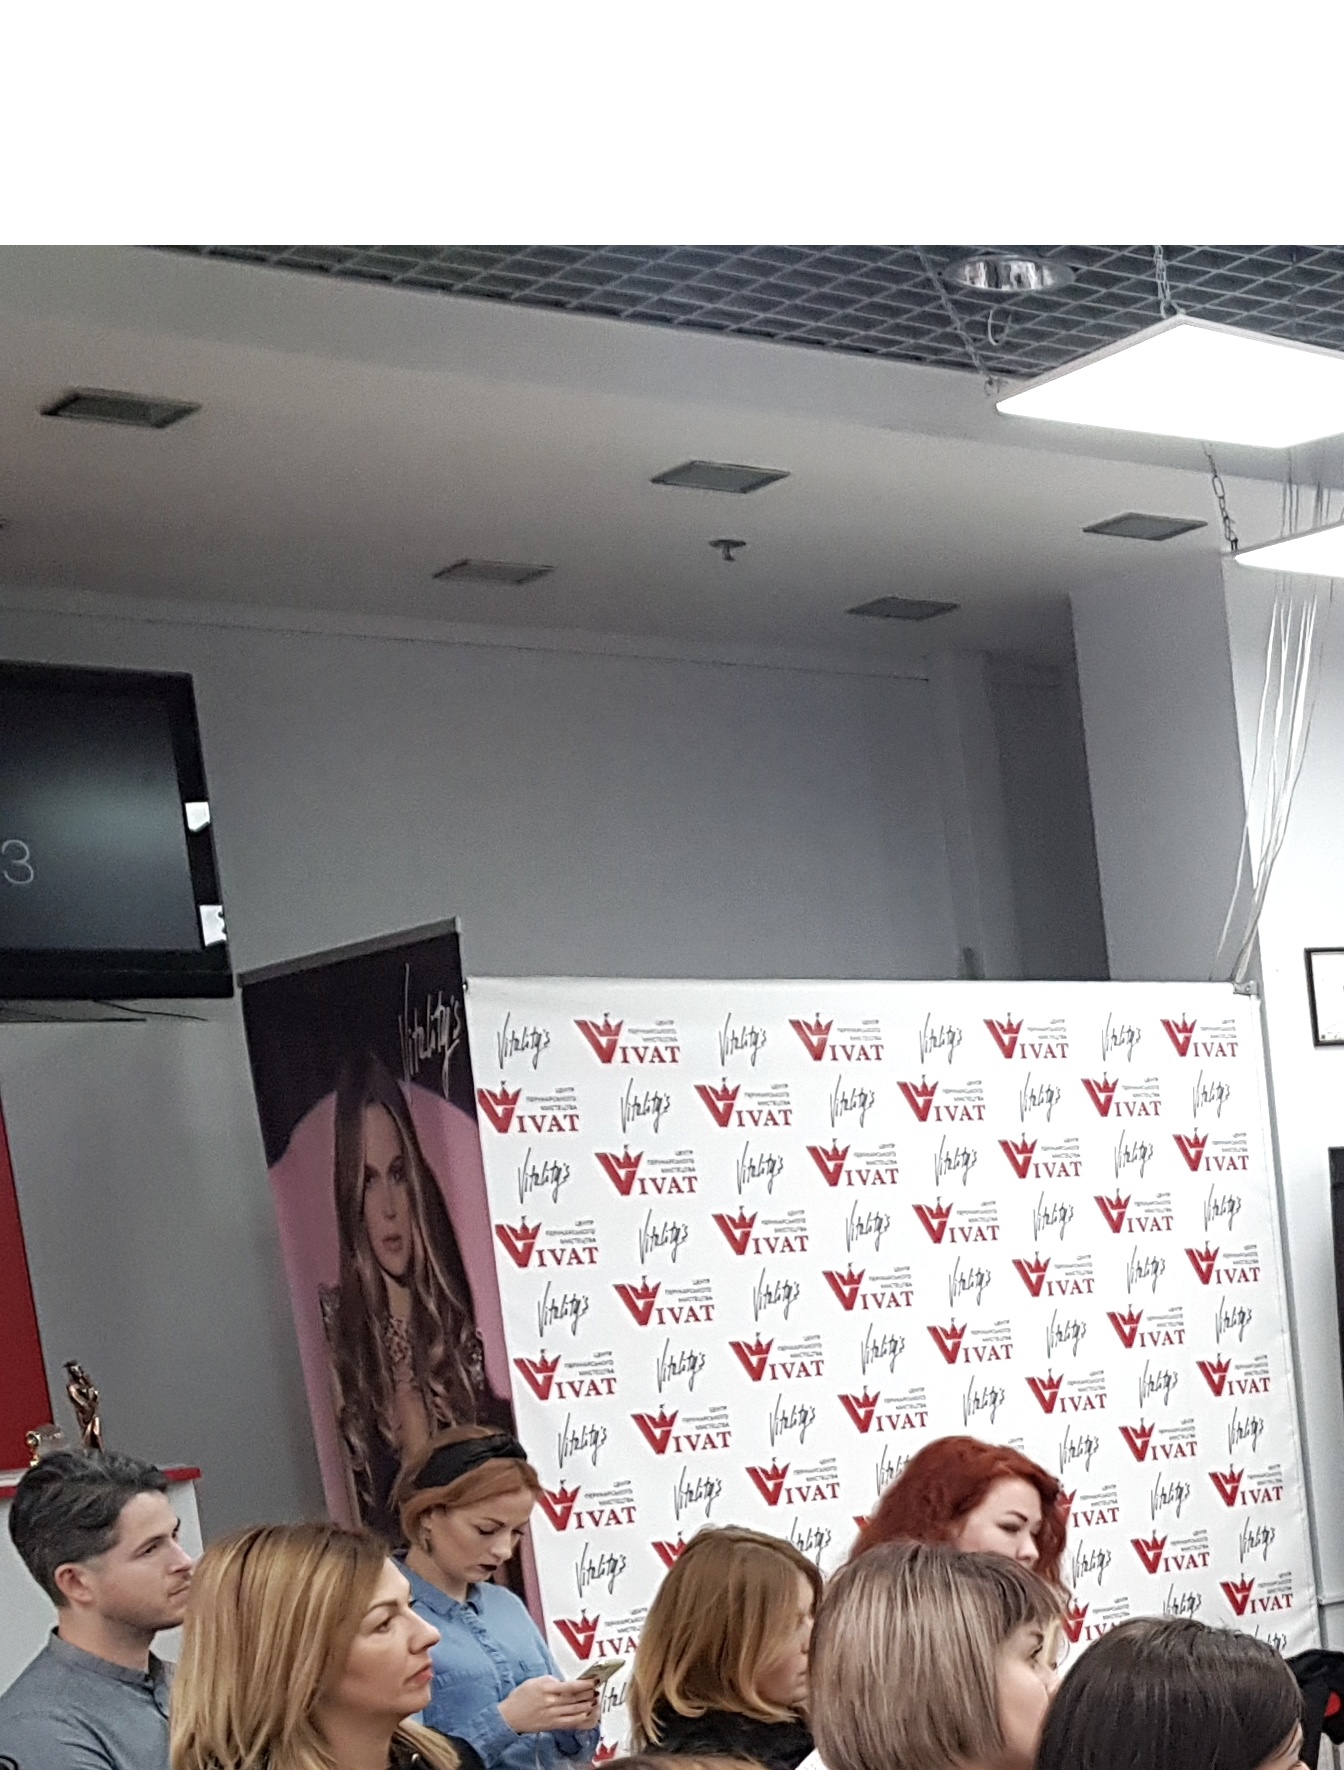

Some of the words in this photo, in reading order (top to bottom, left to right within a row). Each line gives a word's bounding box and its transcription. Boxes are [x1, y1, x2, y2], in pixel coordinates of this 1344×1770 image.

[573, 1019, 680, 1064] VIVAT
[788, 1019, 884, 1061] VIVAT
[983, 1018, 1069, 1059] VIVAT
[1160, 1018, 1238, 1057] VIVAT
[476, 1087, 580, 1133] VIVAT
[694, 1084, 793, 1128] VIVAT
[897, 1080, 985, 1122] VIVAT
[1081, 1077, 1161, 1117] VIVAT
[806, 1144, 899, 1187] VIVAT
[998, 1138, 1082, 1179] VIVAT
[1172, 1132, 1249, 1172] VIVAT
[594, 1151, 698, 1196] VIVAT
[712, 1211, 809, 1256] VIVAT
[912, 1202, 1000, 1244] VIVAT
[1093, 1194, 1174, 1234] VIVAT
[495, 1222, 599, 1268] VIVAT
[1184, 1246, 1260, 1285] VIVAT
[821, 1268, 914, 1311] VIVAT
[1012, 1256, 1094, 1297] VIVAT
[612, 1281, 715, 1326] VIVAT
[927, 1322, 1013, 1364] VIVAT
[1106, 1309, 1185, 1348] VIVAT
[513, 1354, 617, 1401] VIVAT
[728, 1338, 825, 1382] VIVAT
[1196, 1358, 1270, 1397] VIVAT
[837, 1390, 929, 1434] VIVAT
[1025, 1373, 1107, 1414] VIVAT
[631, 1410, 732, 1455] VIVAT
[1119, 1423, 1197, 1462] VIVAT
[745, 1462, 840, 1507] VIVAT
[1208, 1468, 1283, 1507] VIVAT
[1130, 1534, 1210, 1574] VIVAT
[1219, 1577, 1293, 1616] VIVAT
[553, 1614, 637, 1660] VIVA
